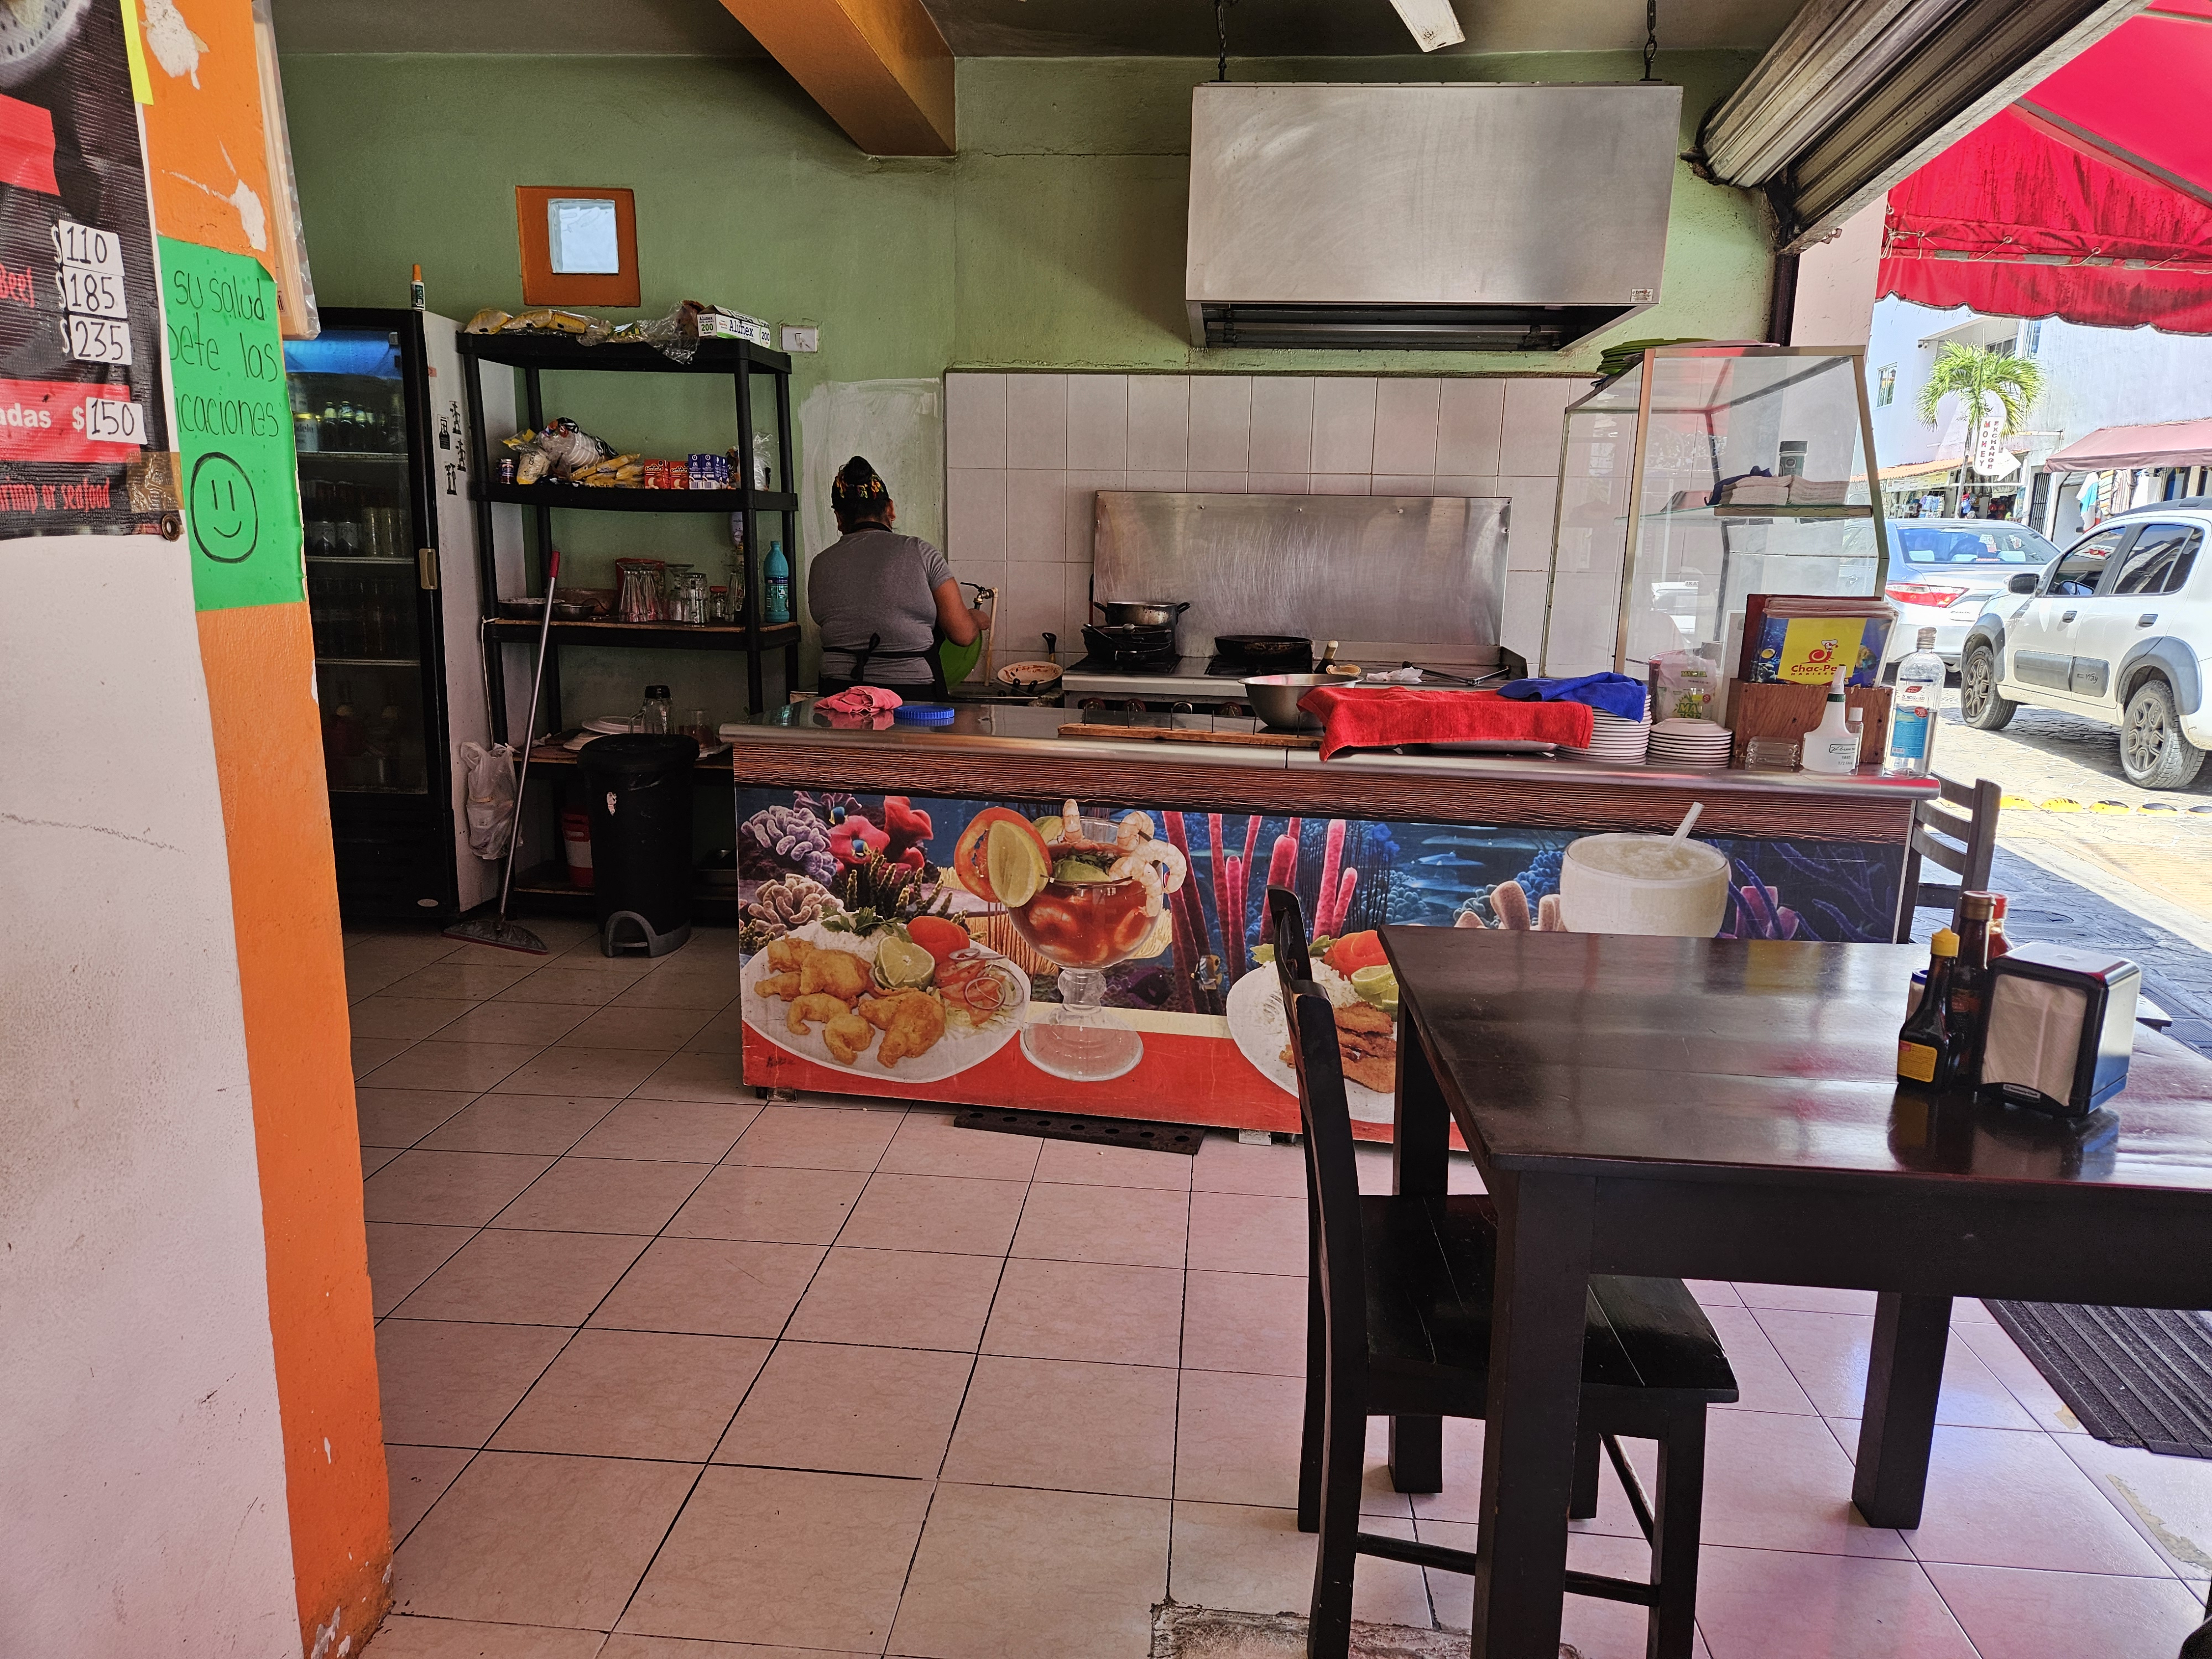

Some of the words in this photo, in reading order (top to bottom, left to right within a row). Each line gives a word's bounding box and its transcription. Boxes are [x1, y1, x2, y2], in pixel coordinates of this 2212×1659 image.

[209, 275, 265, 321] salud
[701, 323, 713, 331] 200
[729, 319, 754, 337] Alumex
[761, 331, 770, 342] 200
[239, 332, 278, 382] las
[1979, 421, 1991, 467] MONEY
[1987, 421, 1999, 469] EXCHANGE
[61, 477, 111, 513] seafood
[2085, 673, 2098, 684] Way
